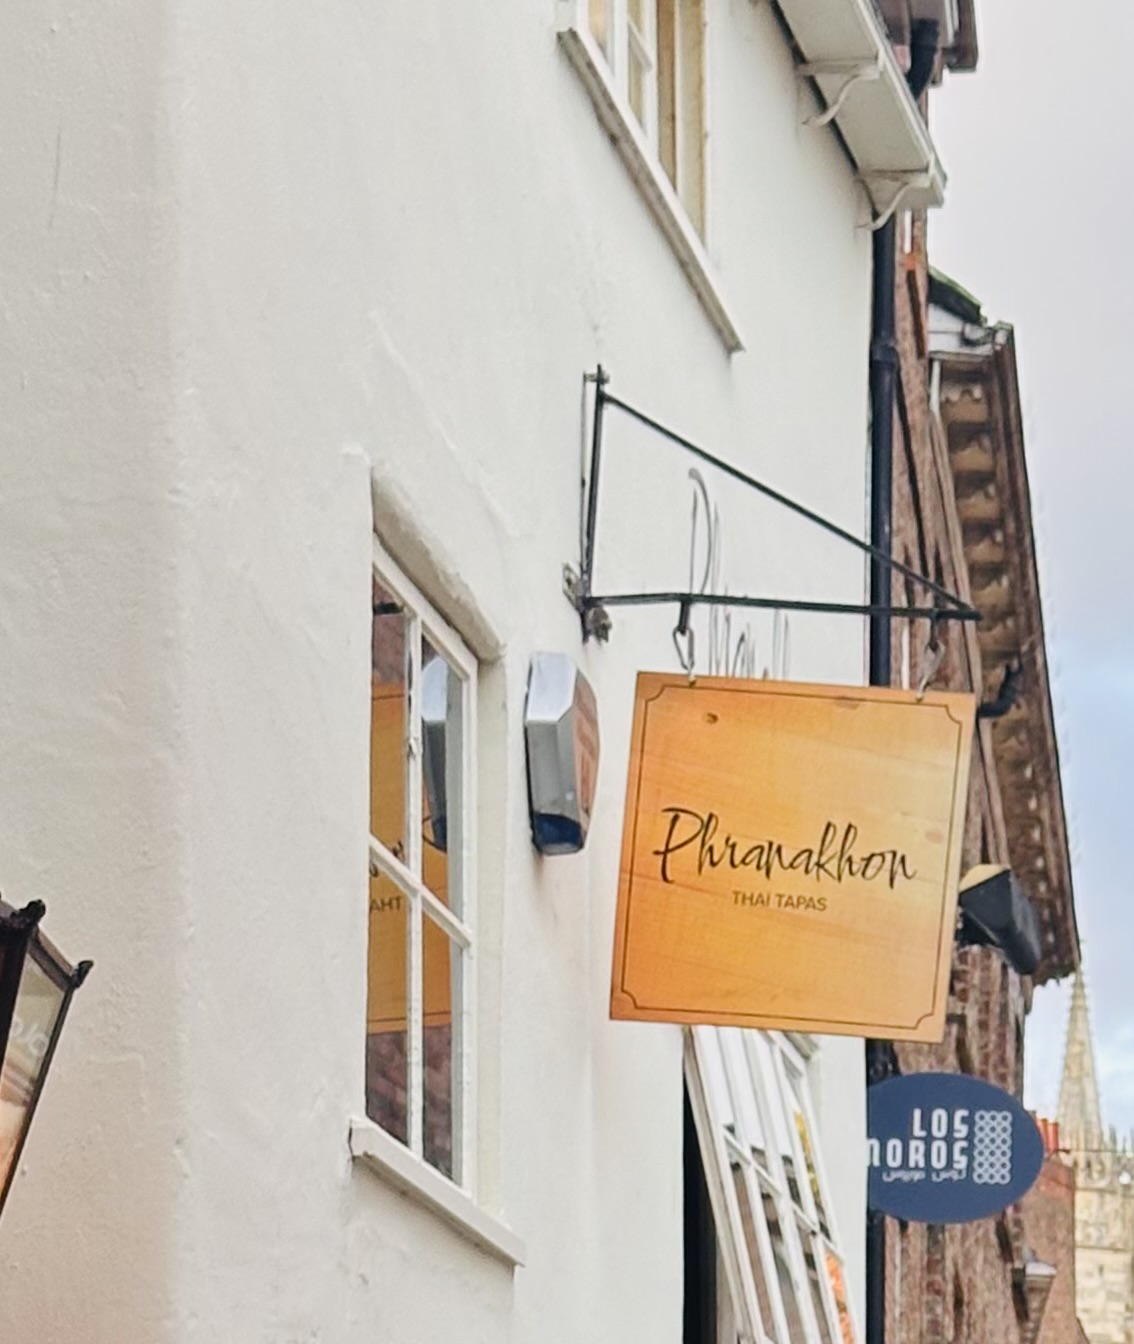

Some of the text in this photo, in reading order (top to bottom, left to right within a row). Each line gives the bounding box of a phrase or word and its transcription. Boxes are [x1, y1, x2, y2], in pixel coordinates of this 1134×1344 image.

[652, 806, 917, 890] Phranakhon
[731, 889, 828, 912] THAI TAPAS
[912, 1107, 969, 1138] LOS
